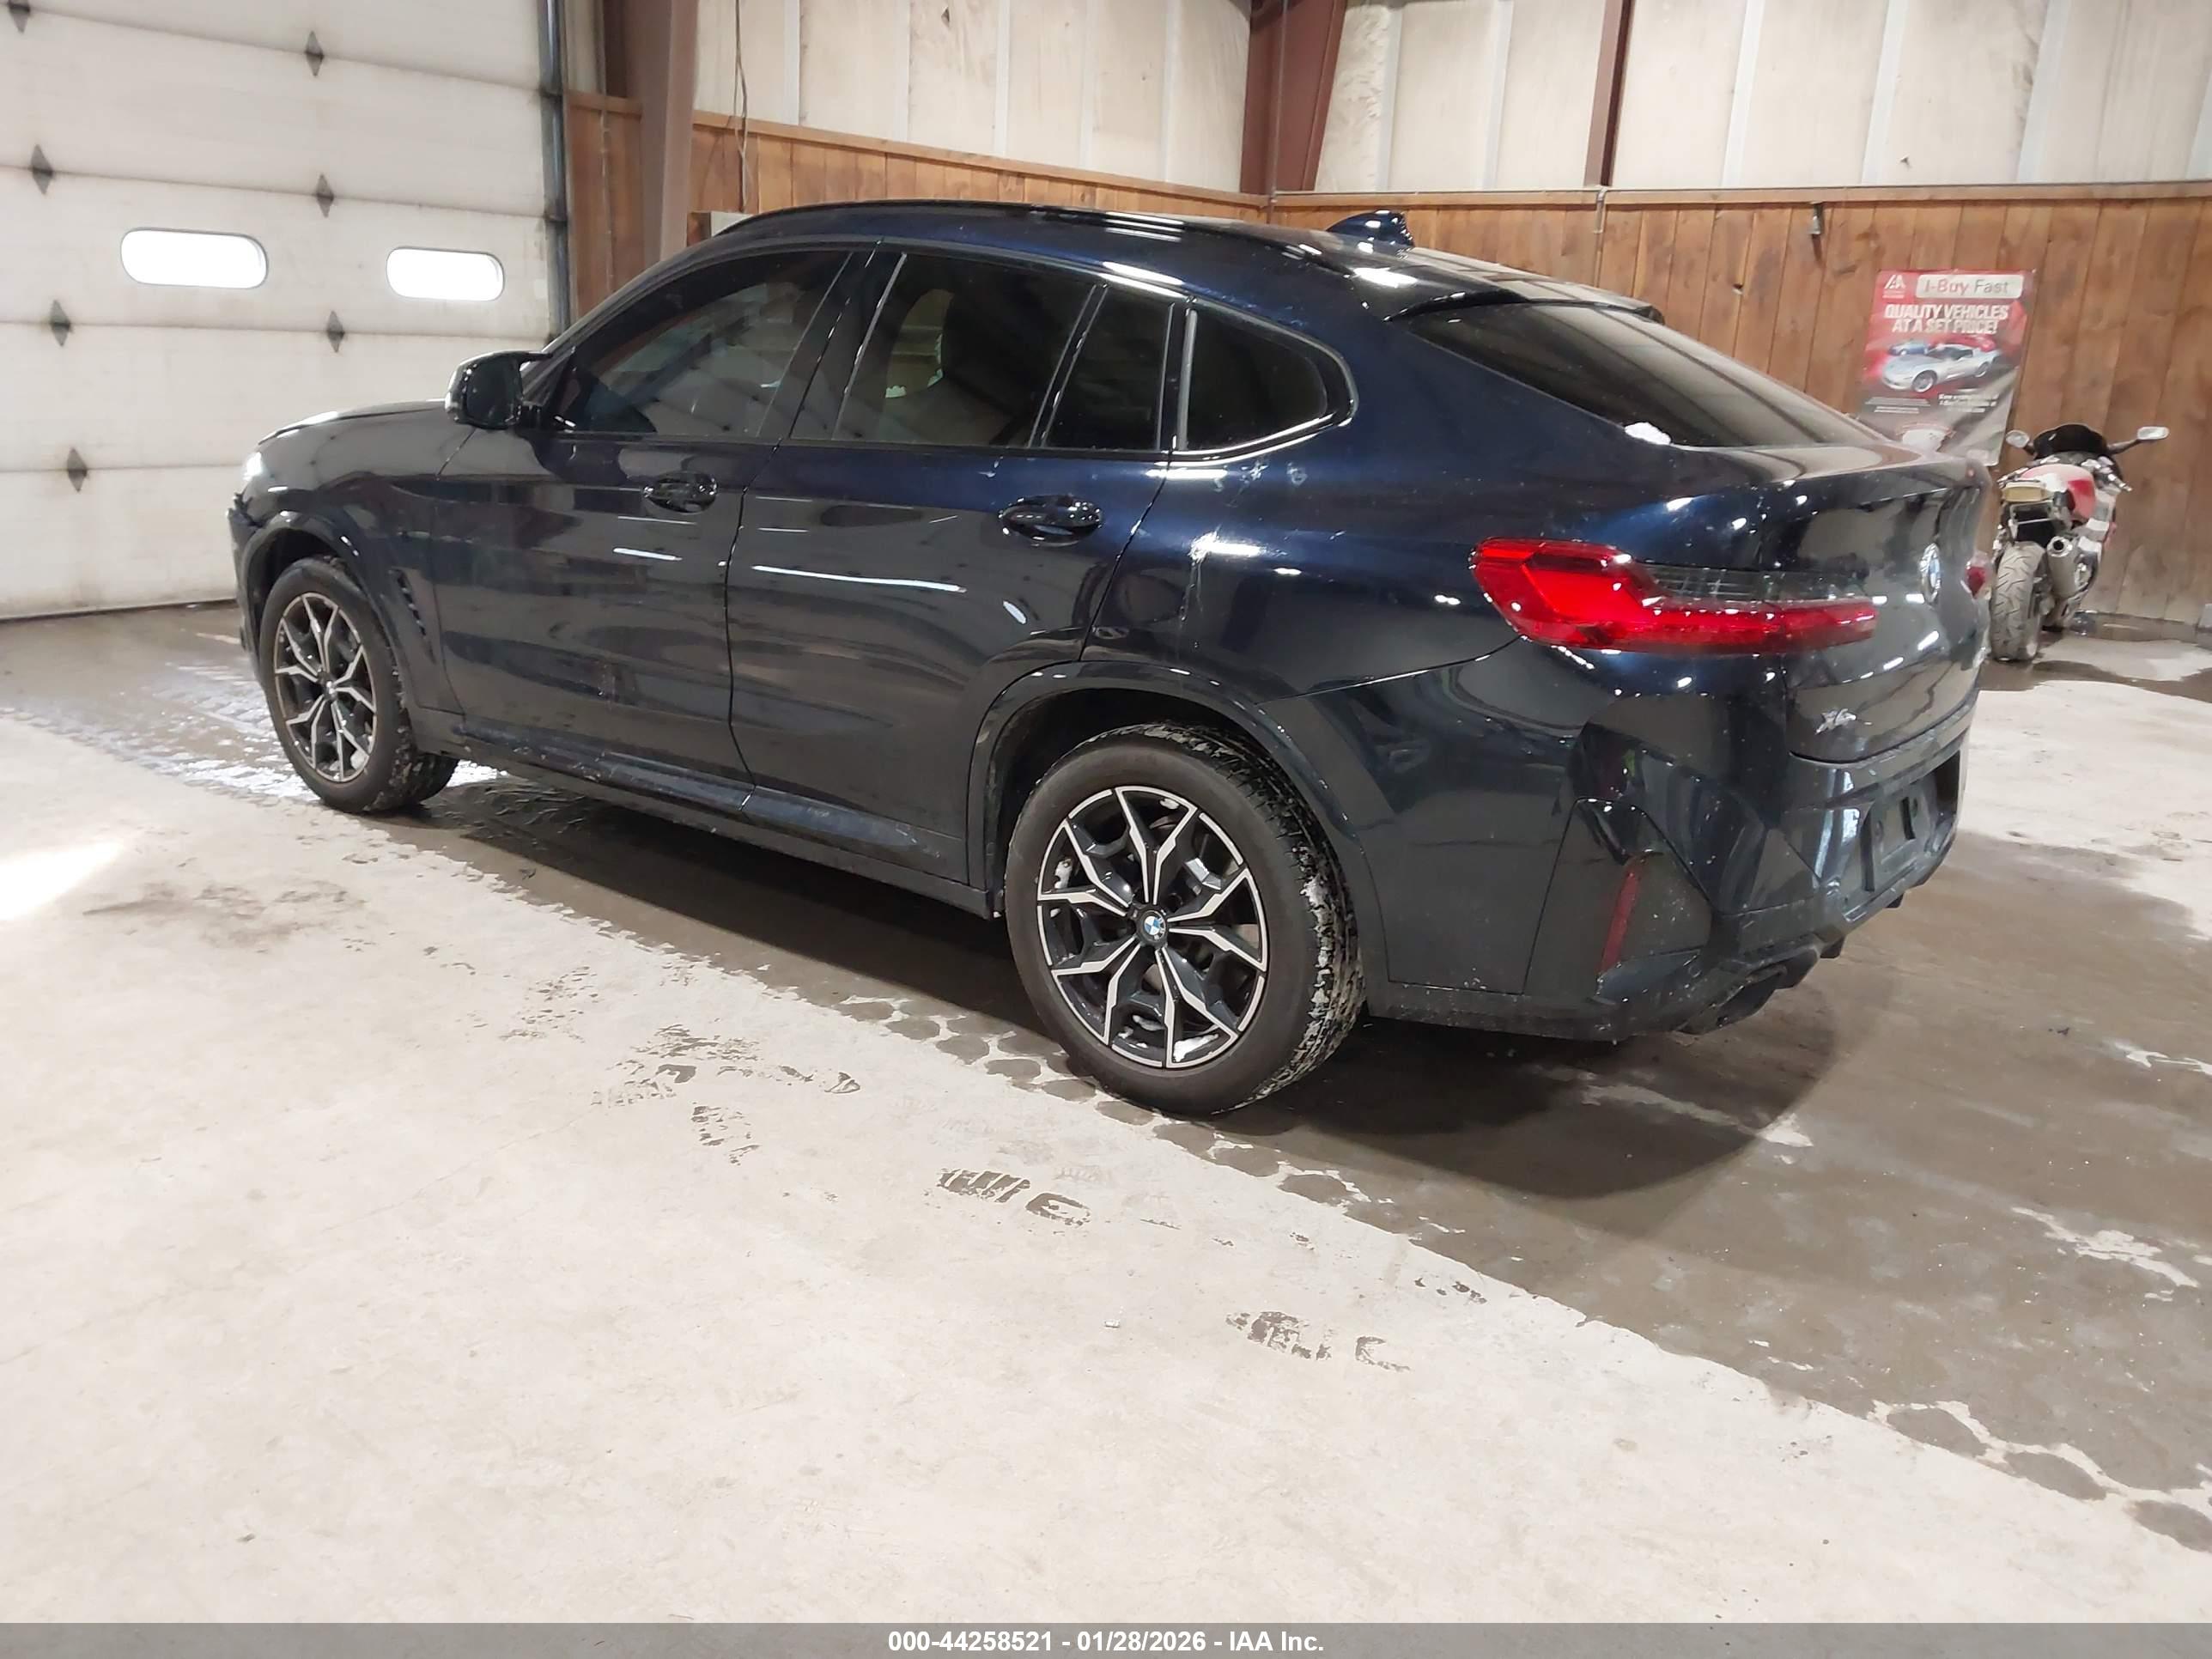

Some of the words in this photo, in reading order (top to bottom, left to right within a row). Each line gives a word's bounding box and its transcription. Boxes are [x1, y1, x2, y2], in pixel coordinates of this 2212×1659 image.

[1924, 278, 1971, 295] I-Buy
[1975, 279, 2009, 294] Fast
[1883, 304, 1943, 319] QUALITY
[1943, 305, 2010, 320] VEHICLES
[1892, 319, 1912, 332] AT
[1911, 319, 1923, 332] A
[1925, 319, 1952, 333] SET
[1952, 319, 1999, 335] PRICE!
